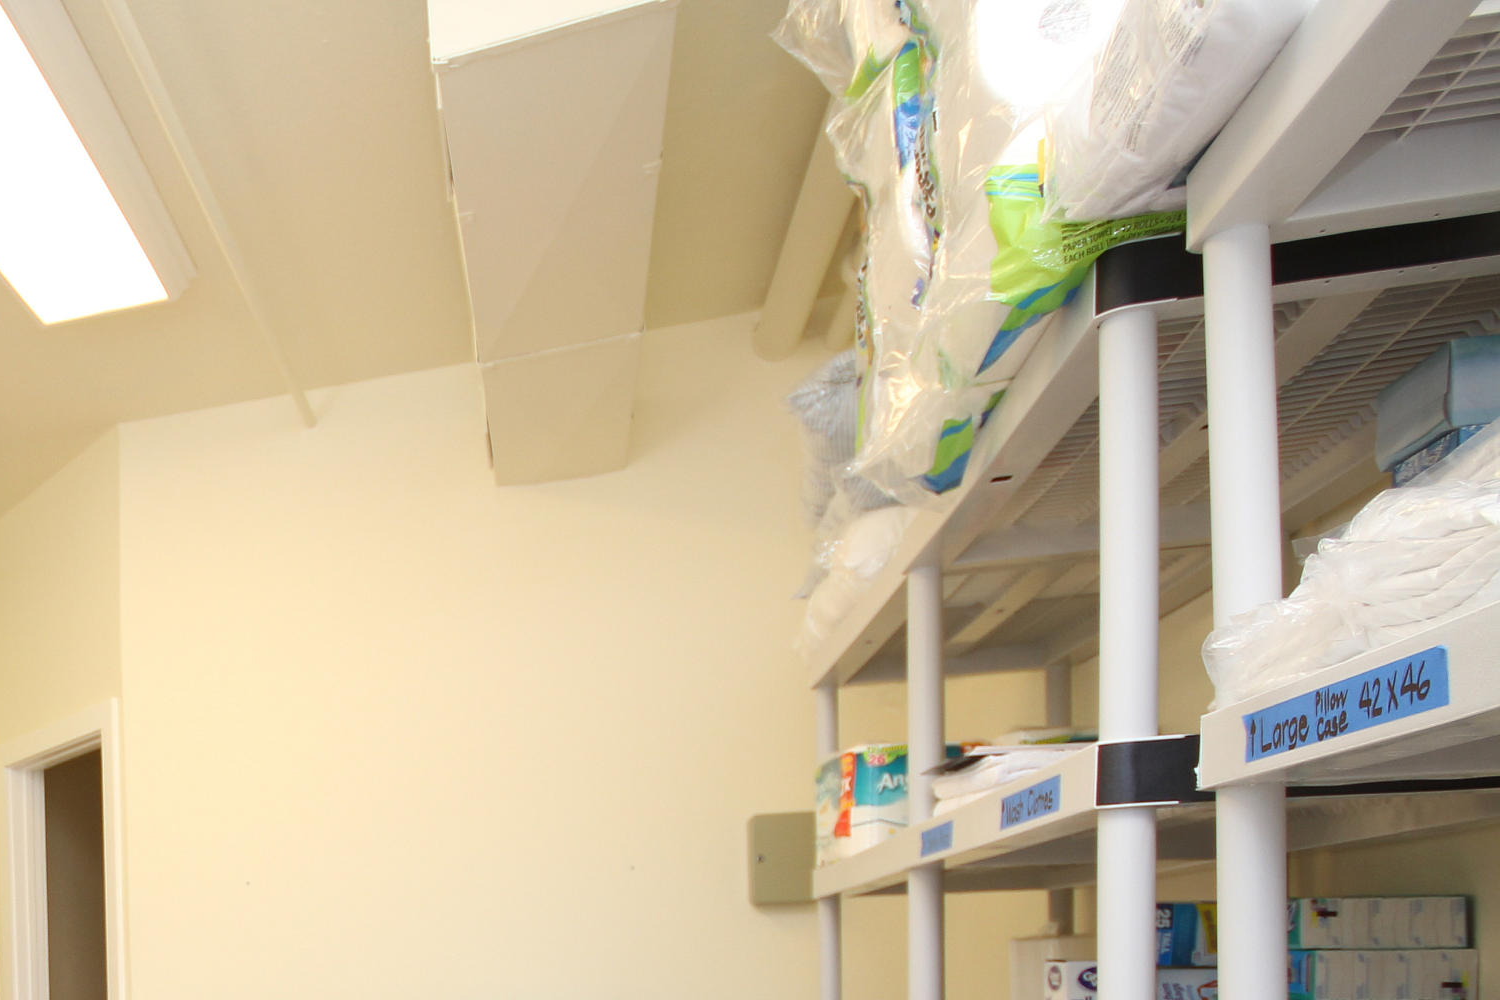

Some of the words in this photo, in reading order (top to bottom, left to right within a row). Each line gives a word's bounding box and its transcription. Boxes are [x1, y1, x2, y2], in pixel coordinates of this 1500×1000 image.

[1063, 252, 1085, 265] EACH
[1260, 714, 1309, 752] Large
[1315, 688, 1349, 717] Pillow
[867, 753, 886, 767] 26
[1156, 909, 1171, 929] 25
